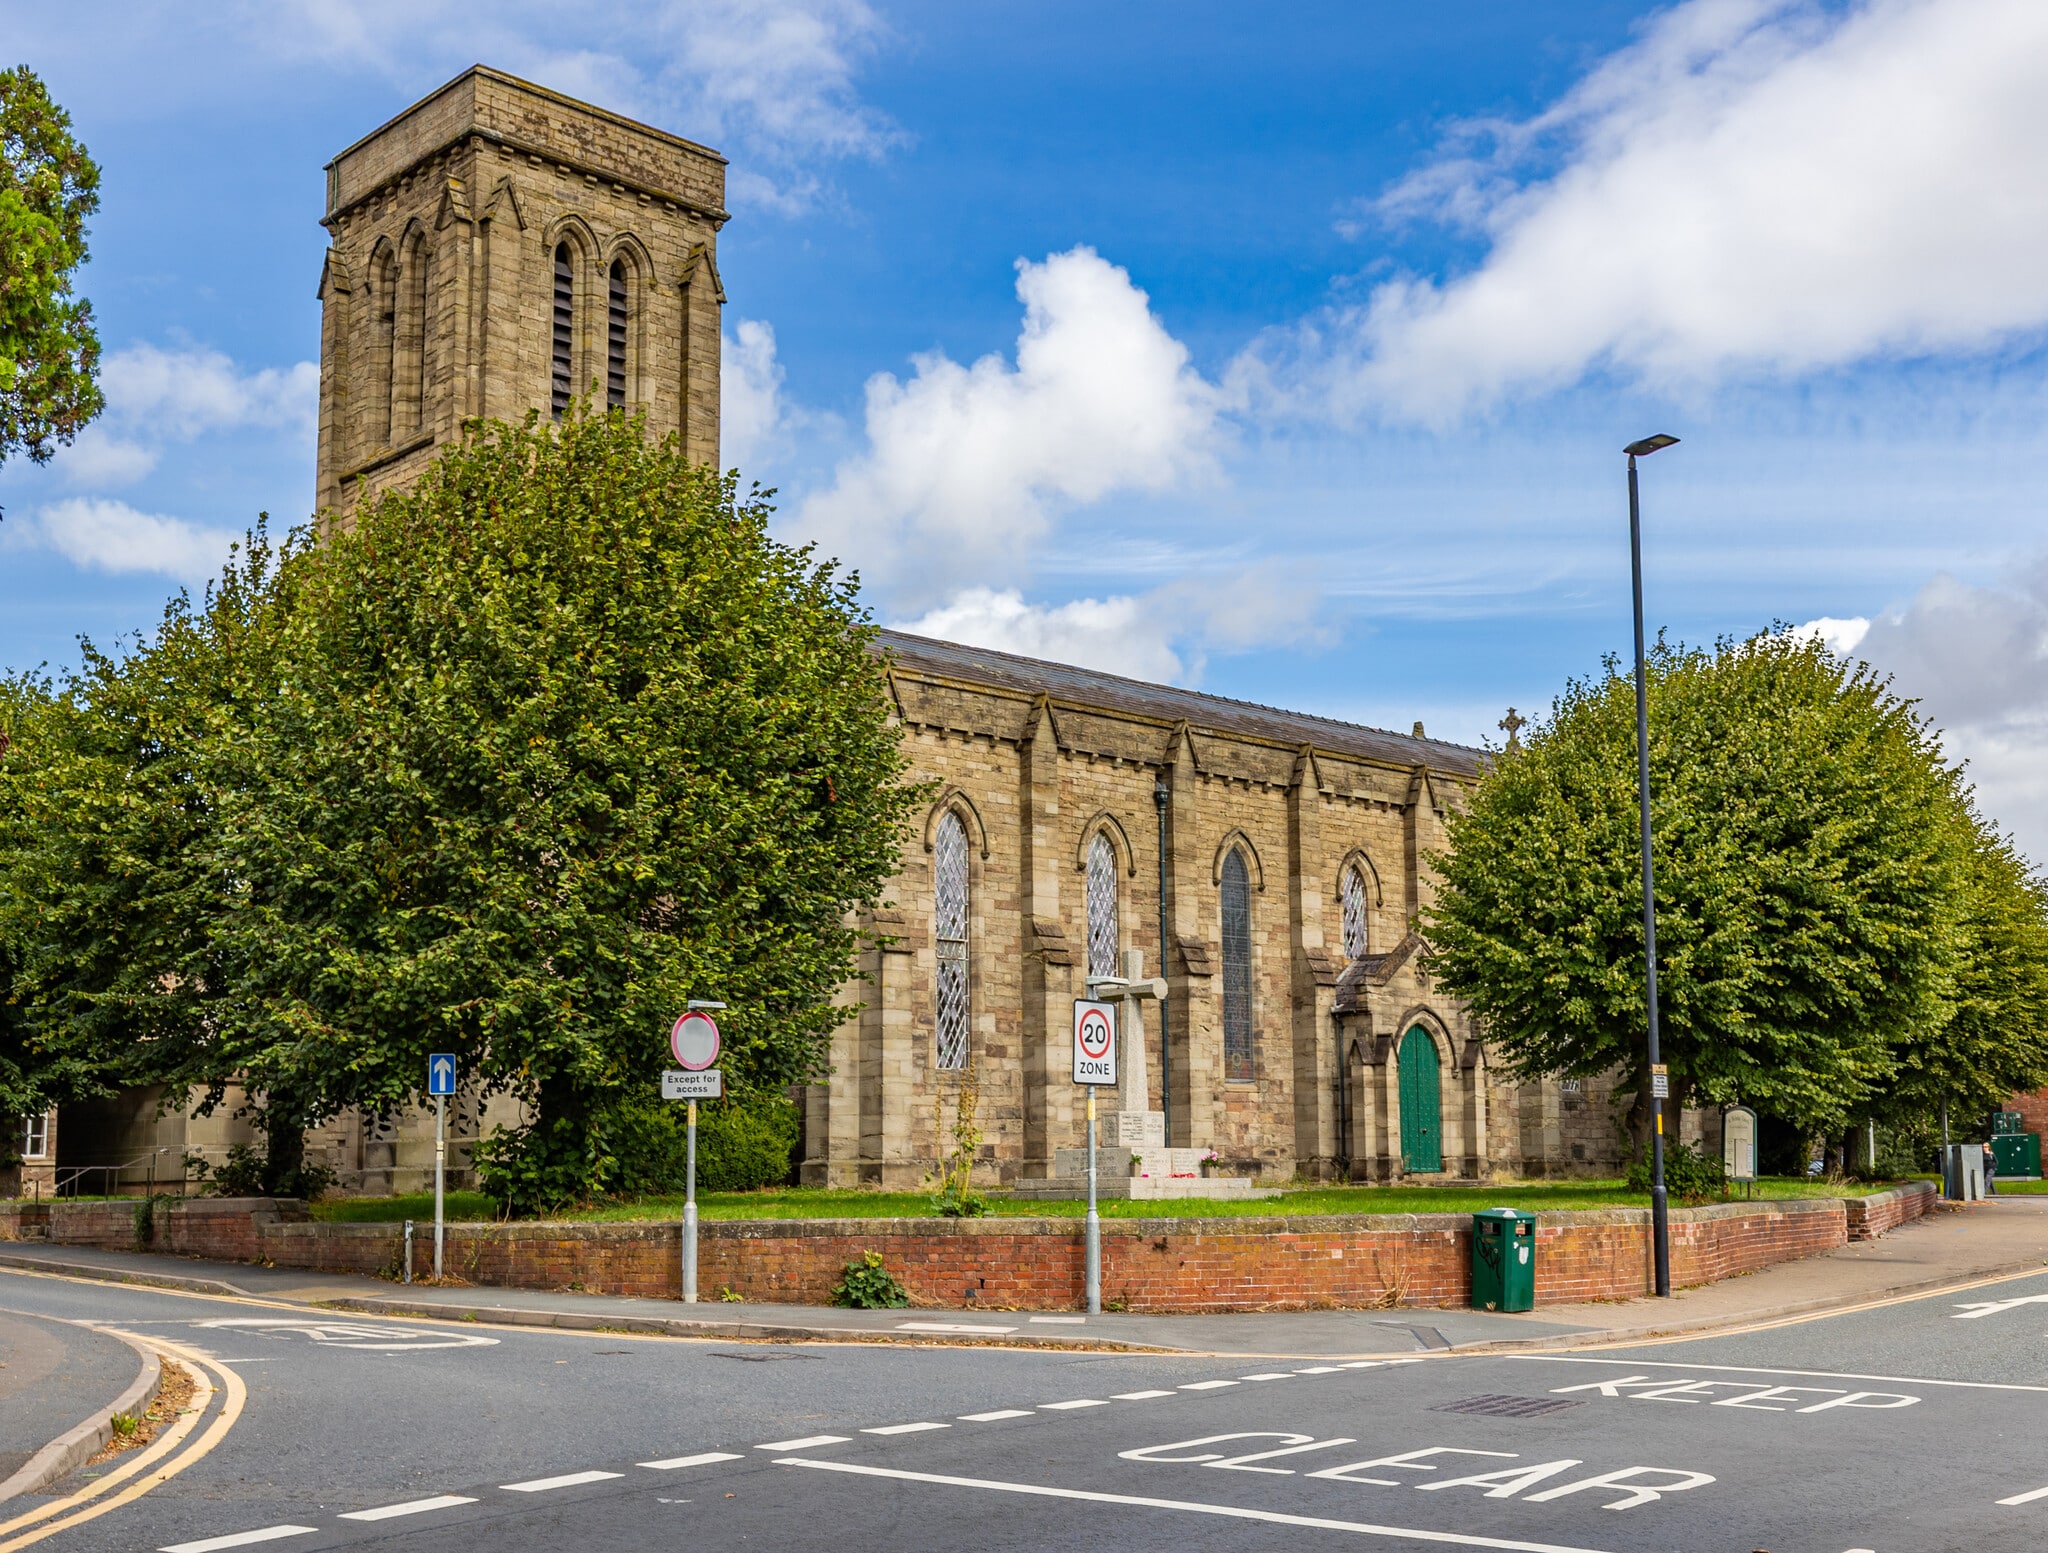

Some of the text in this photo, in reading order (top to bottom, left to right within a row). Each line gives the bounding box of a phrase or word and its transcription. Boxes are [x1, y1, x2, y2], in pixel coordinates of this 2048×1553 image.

[1084, 1023, 1106, 1044] 20
[1080, 1062, 1110, 1075] ZONE
[667, 1075, 717, 1084] Except for
[676, 1085, 708, 1093] access
[1550, 1375, 1922, 1413] KEEP
[1117, 1432, 1717, 1511] CLEAR
